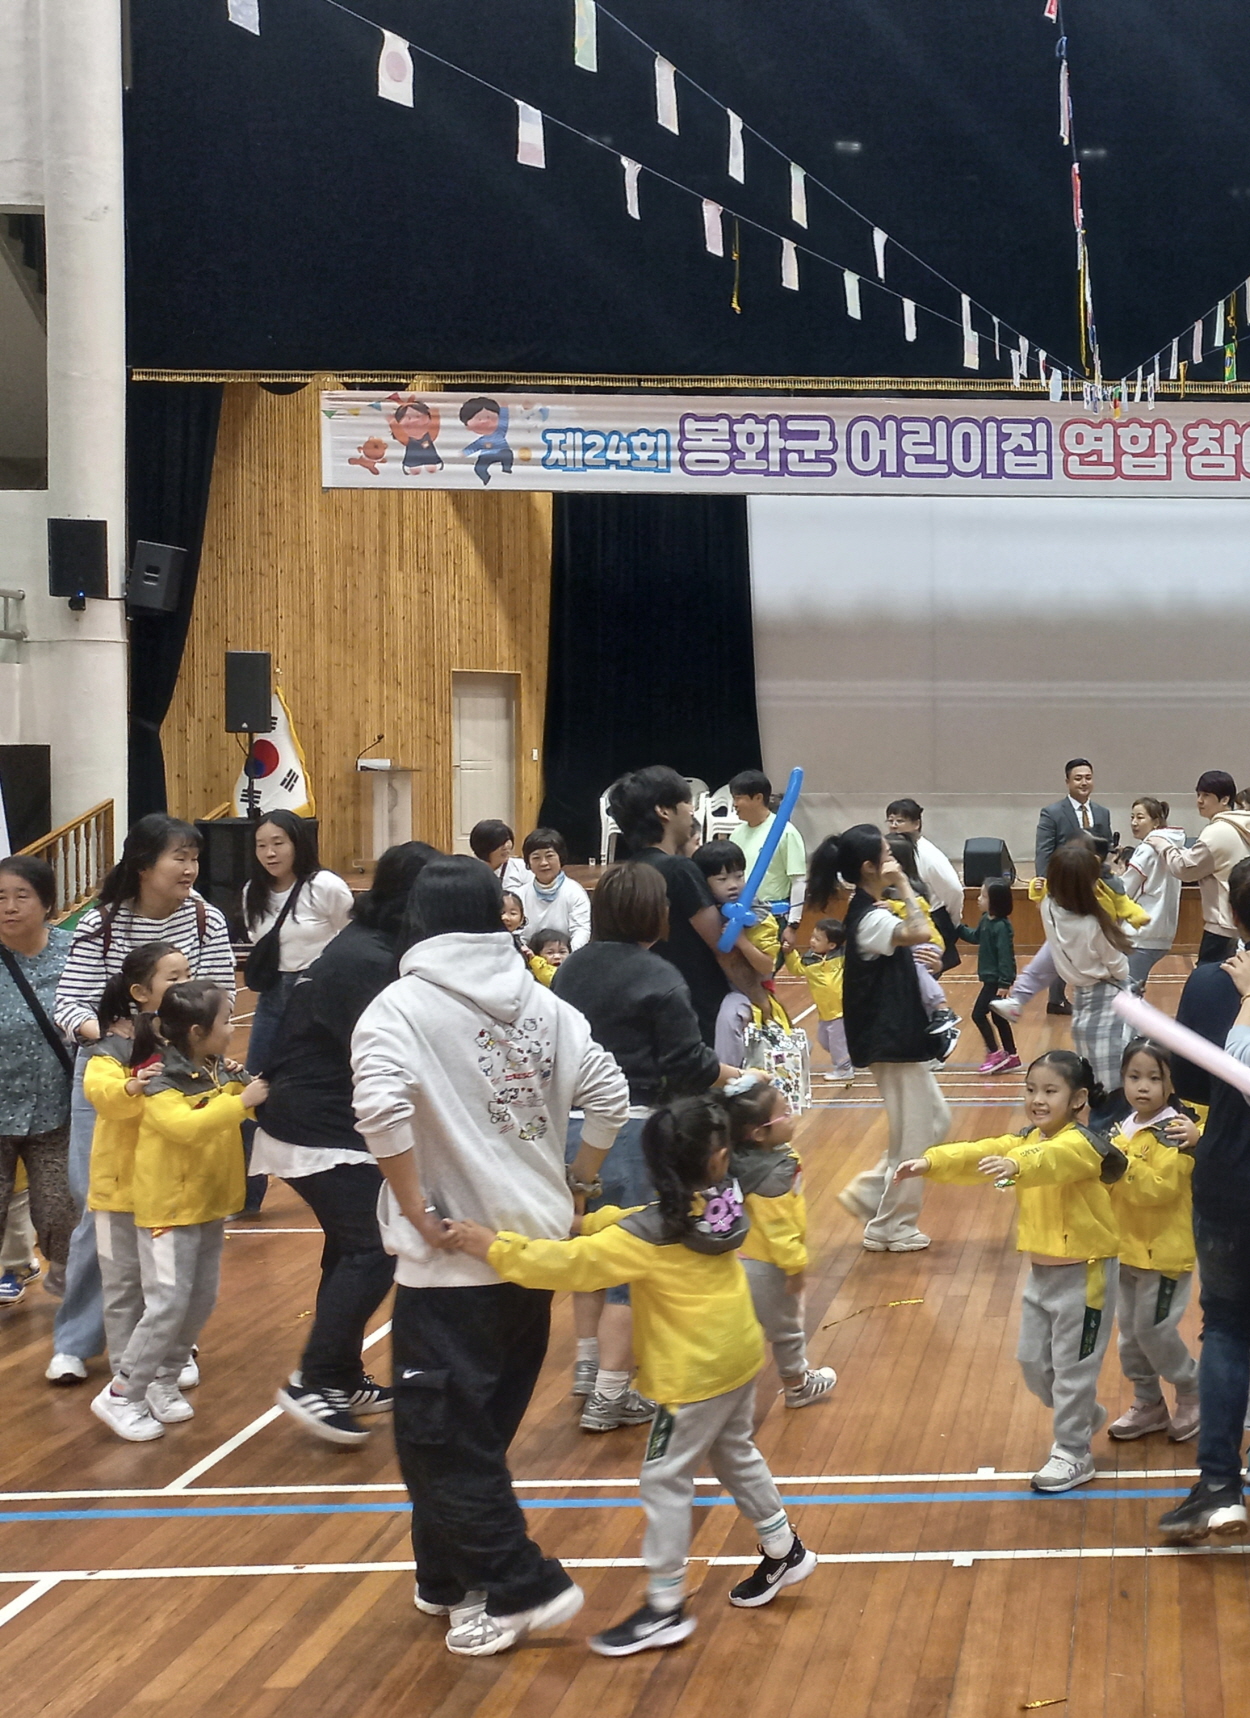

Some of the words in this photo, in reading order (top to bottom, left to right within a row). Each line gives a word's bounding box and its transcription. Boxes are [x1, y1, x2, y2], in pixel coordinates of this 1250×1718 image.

[541, 428, 671, 473] 제24회
[678, 412, 838, 476] 봉화군
[846, 415, 1053, 480] 어린이집
[1060, 417, 1178, 481] 연합
